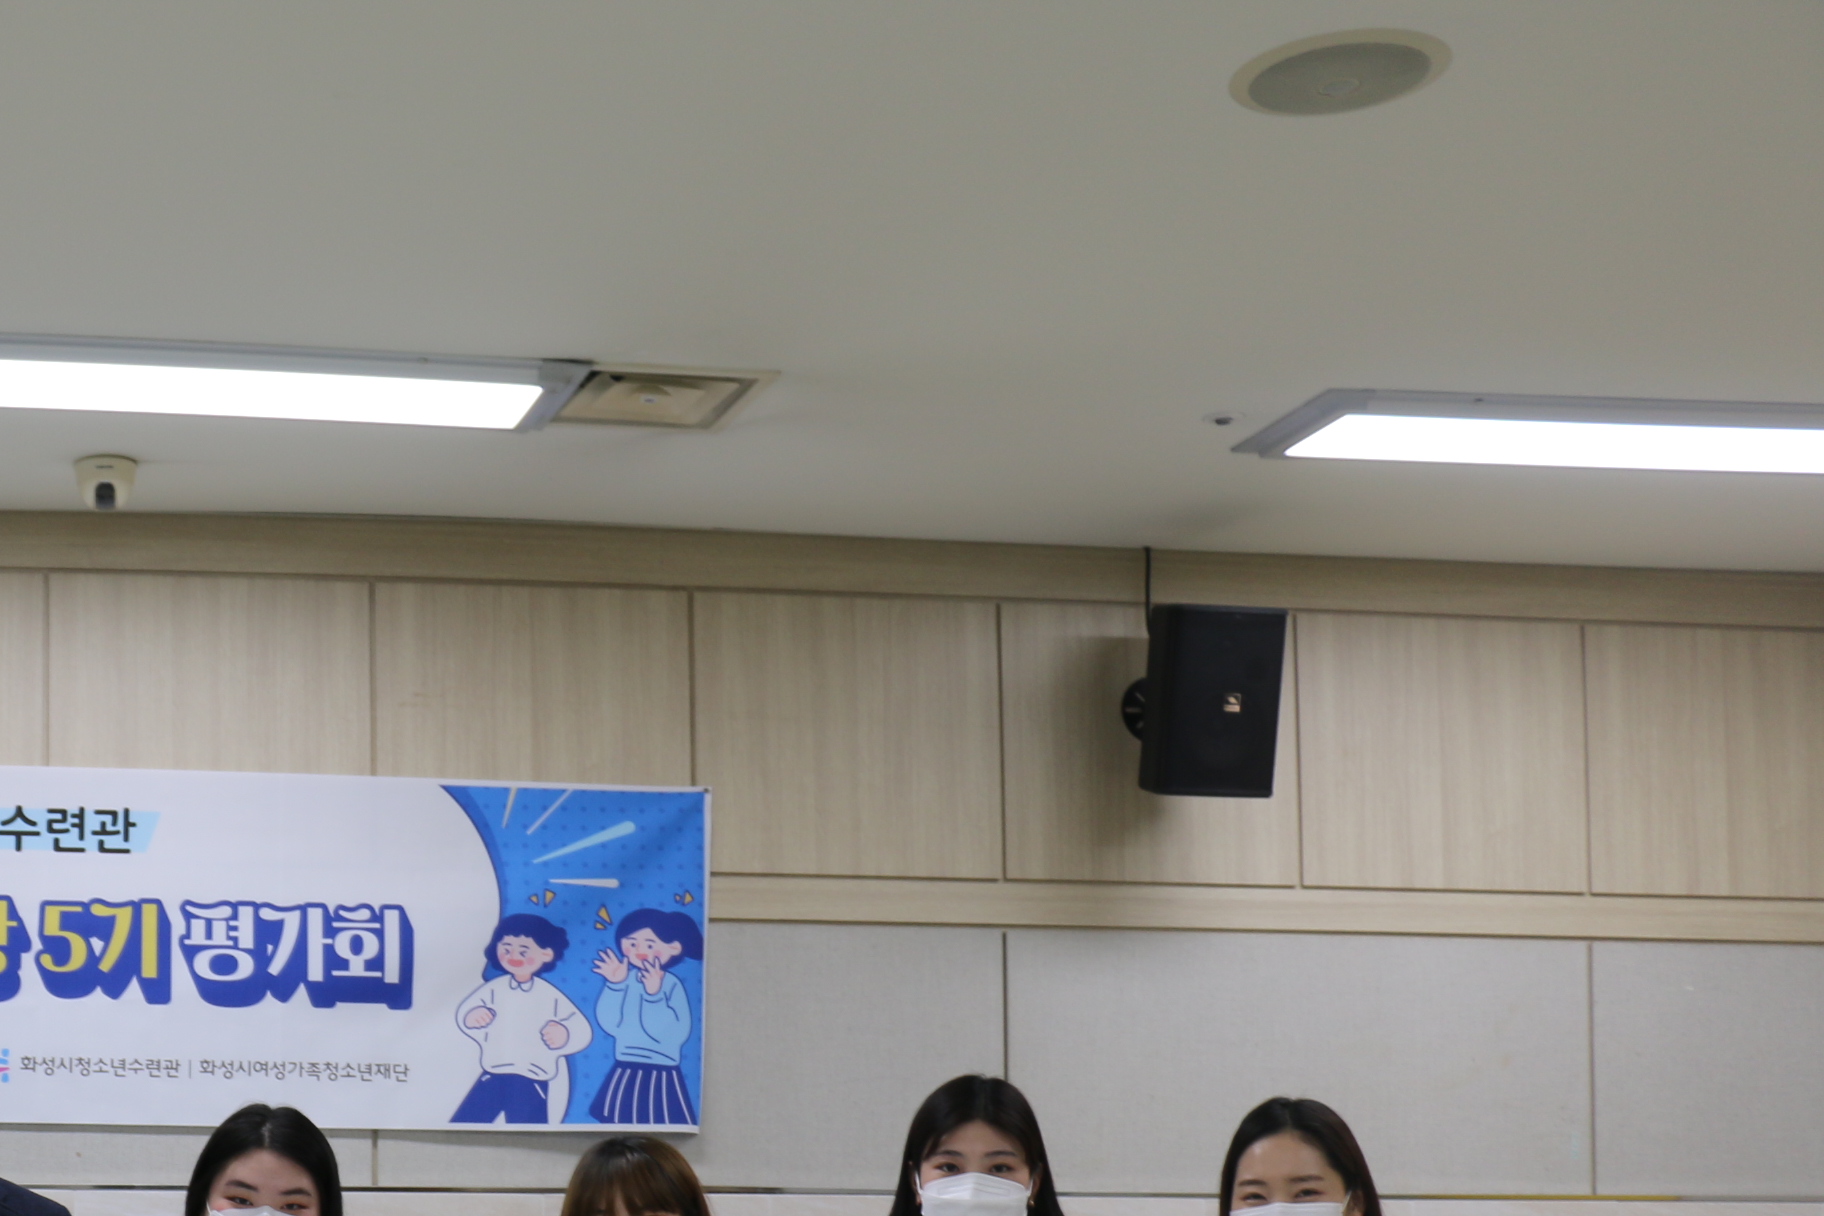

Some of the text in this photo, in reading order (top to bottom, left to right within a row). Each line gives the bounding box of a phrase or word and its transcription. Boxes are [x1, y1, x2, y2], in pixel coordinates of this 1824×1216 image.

[38, 898, 164, 987] 5기
[182, 901, 405, 992] 평가회
[19, 1055, 182, 1079] 화성시청소년수련관
[198, 1057, 411, 1083] 화성시여성가족청소년재단
